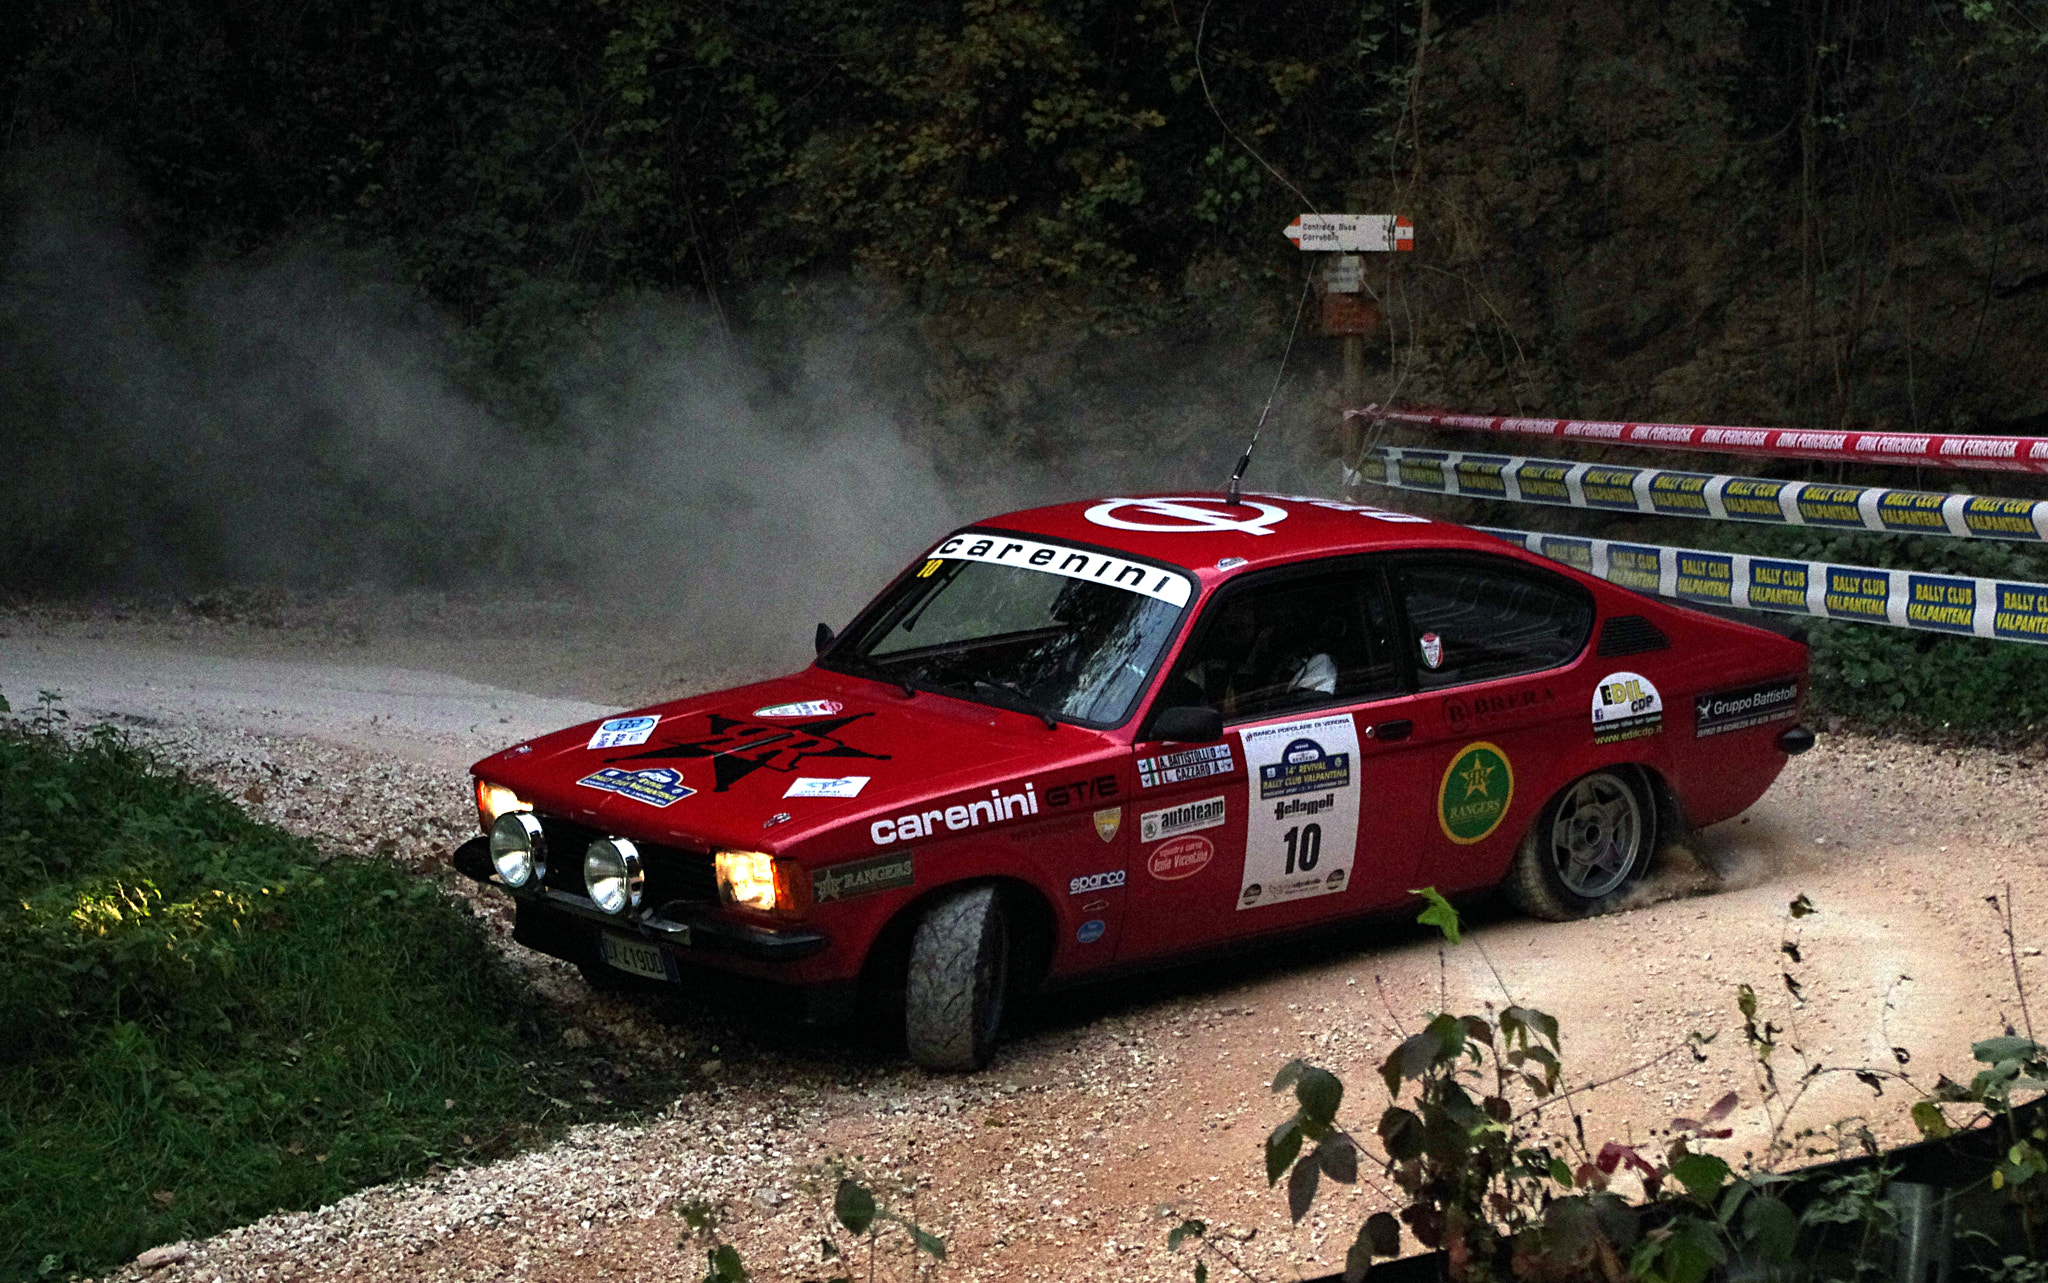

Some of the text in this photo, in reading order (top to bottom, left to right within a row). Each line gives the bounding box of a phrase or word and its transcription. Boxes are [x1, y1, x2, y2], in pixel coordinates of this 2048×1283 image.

[1856, 436, 1930, 453] ZONA PERICOLOSA
[1940, 439, 2019, 457] ZONA PERICOLOSA
[1884, 493, 1945, 508] RALLY CLUB
[1970, 499, 2034, 513] RALLY CLUB
[917, 559, 944, 578] 10
[939, 538, 1170, 593] carenini
[1682, 559, 1730, 579] RALLY CLUB
[1677, 577, 1731, 598] VALPANTENA
[1755, 567, 1806, 588] RALLY CLUB
[1833, 575, 1887, 596] RALLY CLUB
[1750, 586, 1806, 606] VALPANTENA
[1827, 594, 1886, 616] VALPANTENA
[1916, 584, 1973, 605] RALLY CLUB
[2004, 591, 2035, 611] RALLY
[1908, 603, 1973, 626] VALPANTENA
[1600, 680, 1645, 706] EDIL
[1631, 695, 1654, 712] CDP
[1714, 697, 1752, 715] Gruppo
[1753, 684, 1797, 707] Battistolli
[1253, 729, 1277, 738] BANCA
[1278, 723, 1313, 734] POPOLARE
[1323, 718, 1350, 727] VERONA
[1594, 724, 1663, 745] www.edilcdp.it
[1168, 749, 1209, 767] BATTISTOLLI
[1299, 762, 1327, 773] REVIVAL
[1175, 763, 1211, 780] CAZZARO
[1263, 779, 1284, 790] RALLY
[1285, 776, 1302, 786] CLUB
[1304, 769, 1348, 782] VALPANTENA
[1045, 775, 1119, 806] GT/E
[870, 782, 1039, 845] carenini
[1162, 800, 1224, 827] autoteam
[1449, 799, 1500, 819] RANGERS
[1284, 823, 1322, 875] 10
[844, 860, 912, 888] RANGERS
[1070, 870, 1126, 893] sparco
